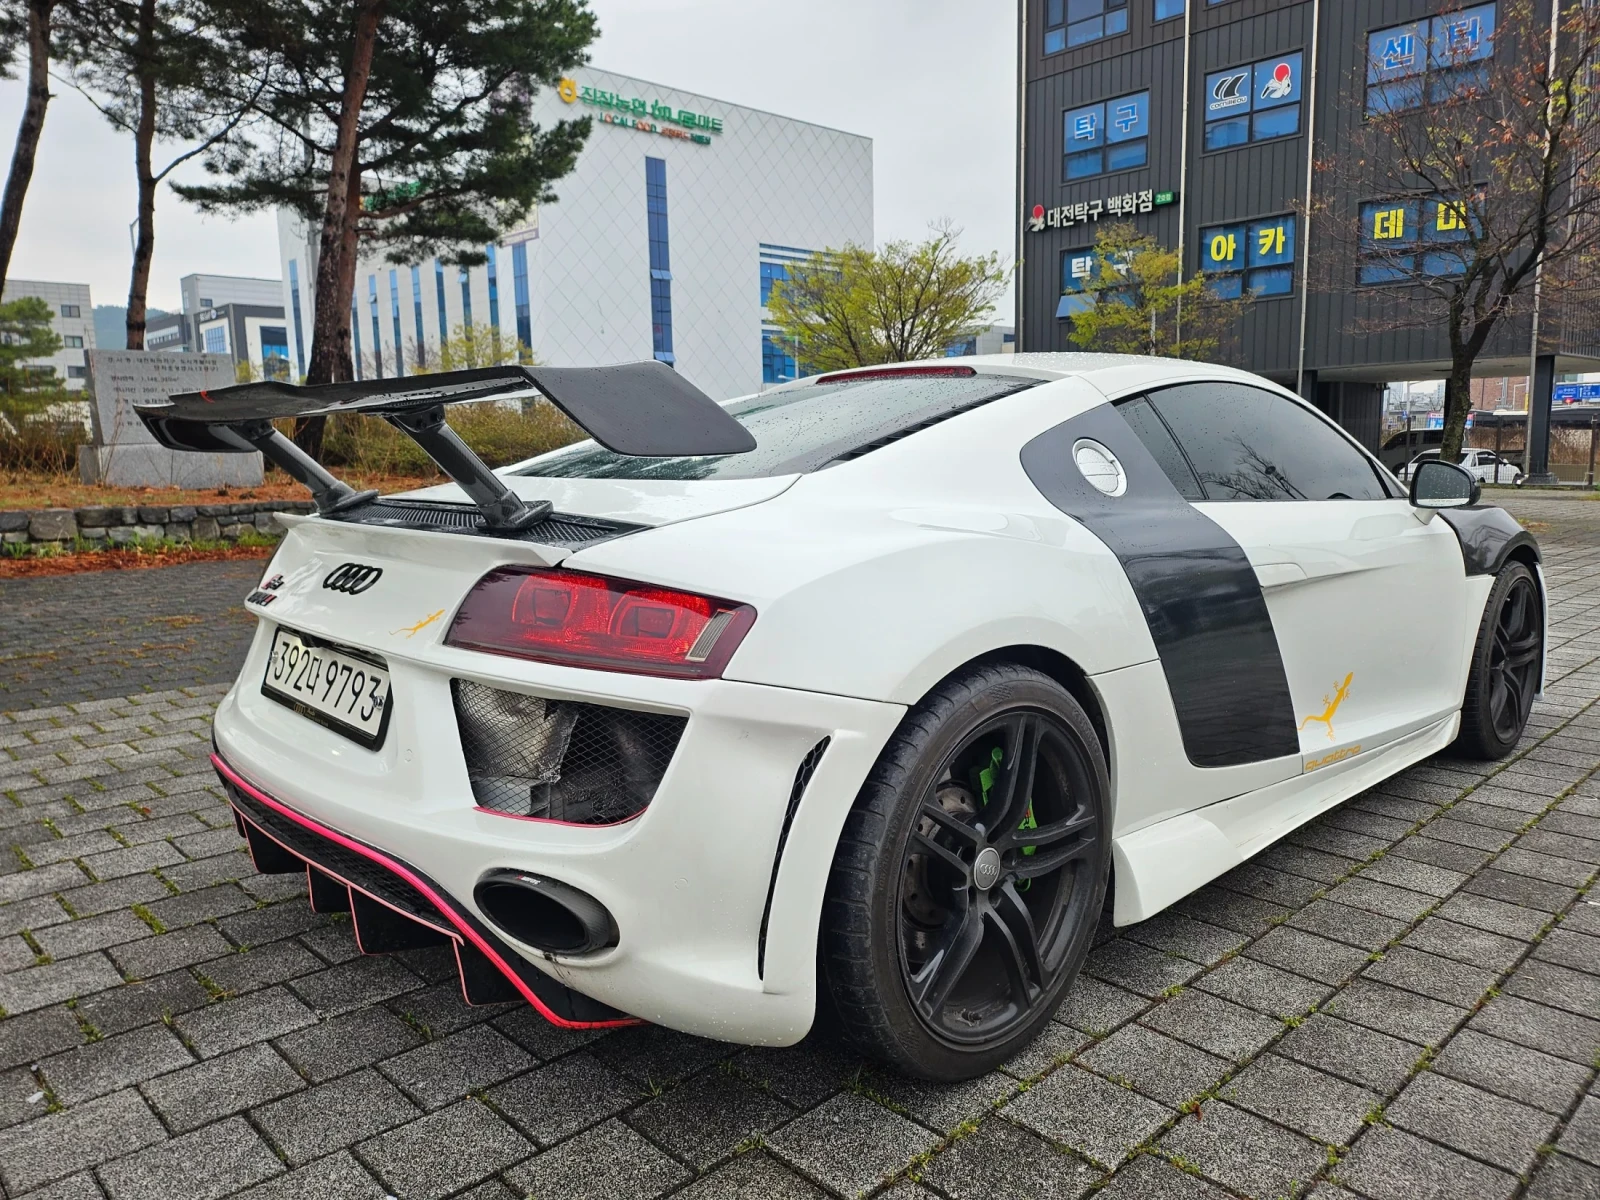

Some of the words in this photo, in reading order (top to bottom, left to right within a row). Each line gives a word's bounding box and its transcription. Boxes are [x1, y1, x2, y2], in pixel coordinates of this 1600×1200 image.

[581, 86, 647, 117] 진잠농협
[1074, 102, 1139, 141] 탁구
[1047, 200, 1104, 228] 대전탁구
[1107, 188, 1153, 217] 백화점
[322, 660, 382, 721] 9793
[1305, 744, 1361, 771] quattro
